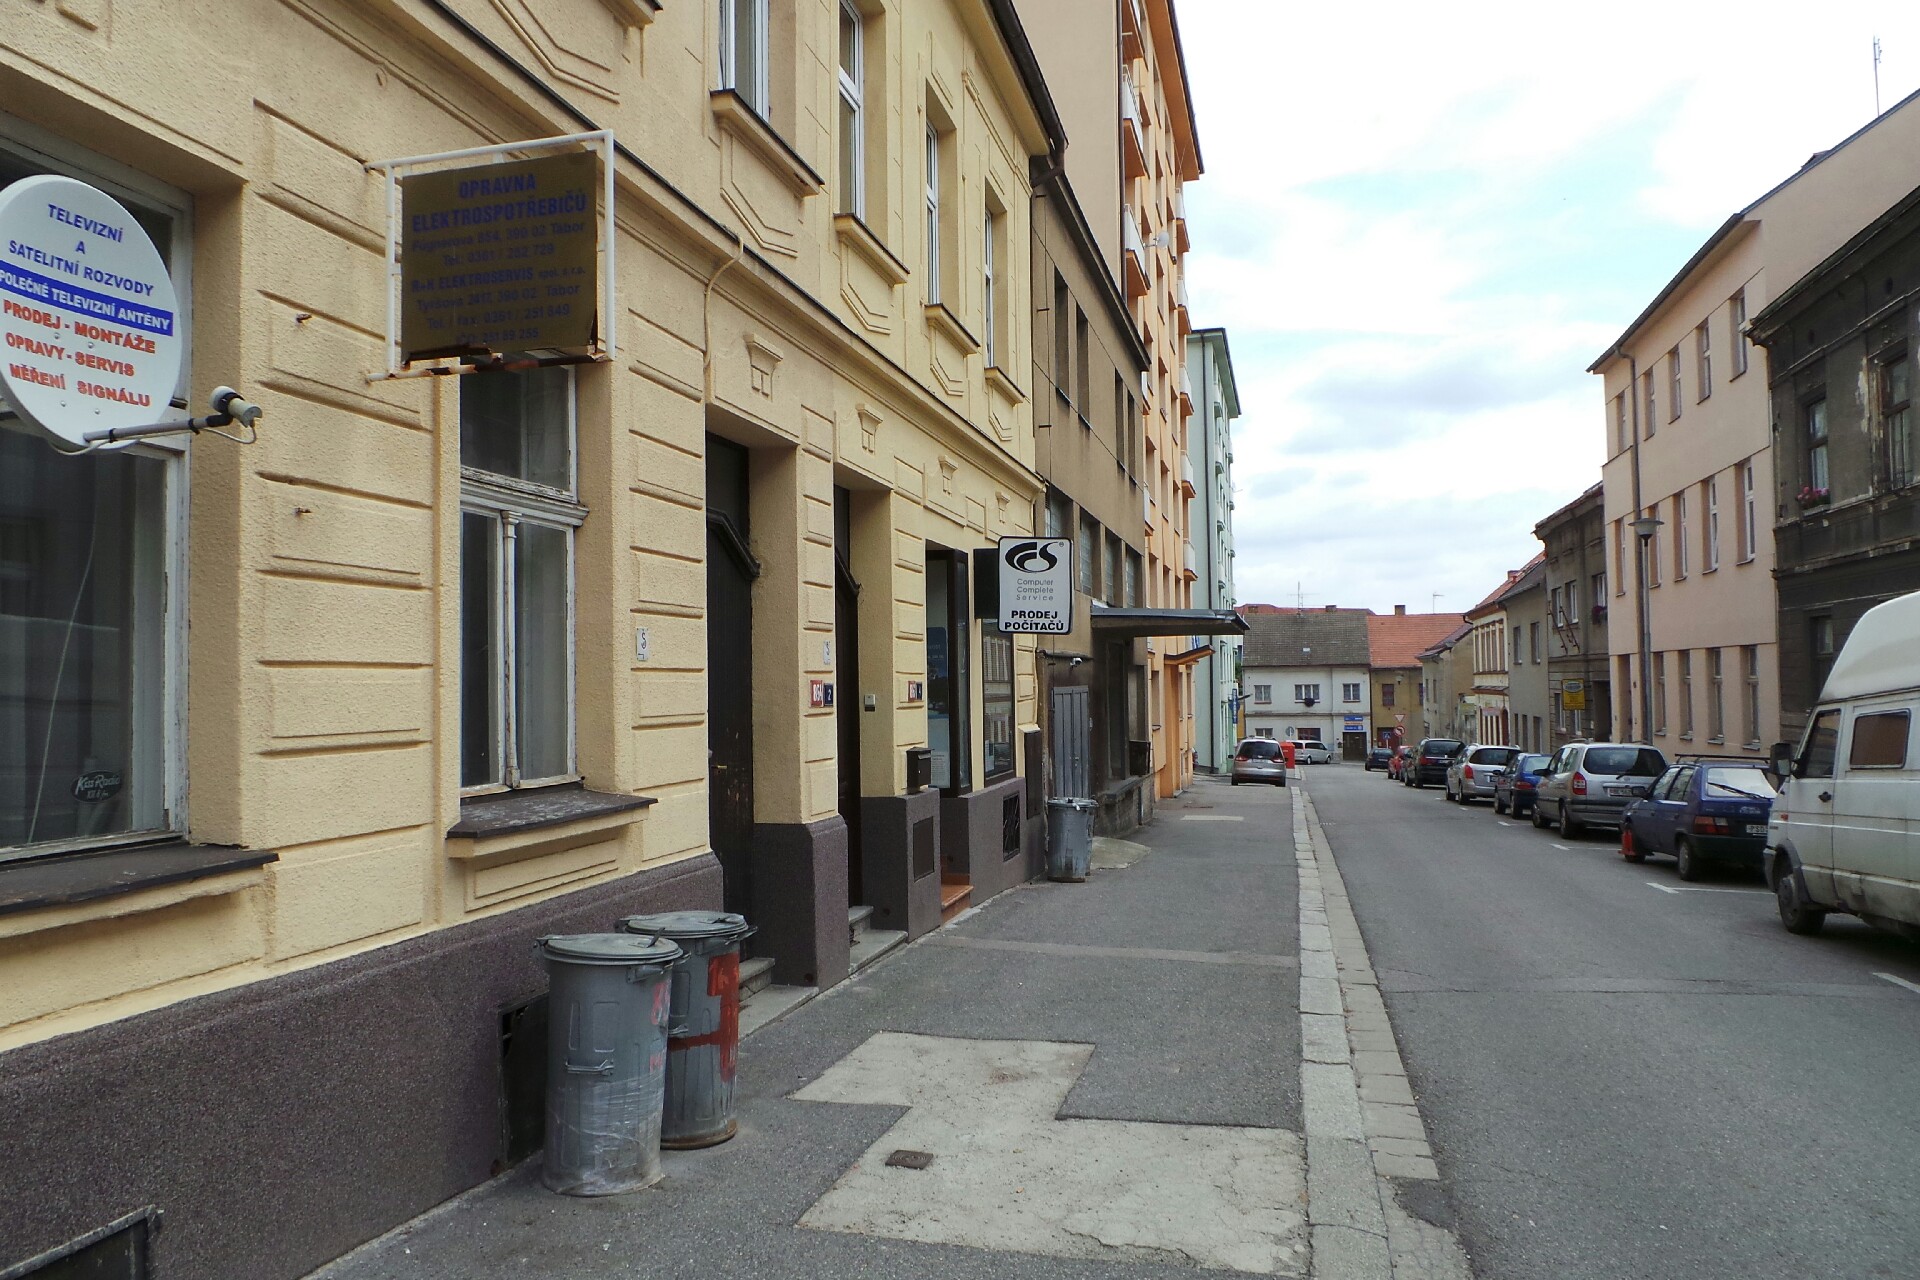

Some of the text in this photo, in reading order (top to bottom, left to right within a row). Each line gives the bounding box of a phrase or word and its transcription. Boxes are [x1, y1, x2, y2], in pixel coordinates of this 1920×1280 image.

[459, 173, 536, 198] OPRAVNA
[48, 203, 124, 243] TELEVIZNÍ
[412, 189, 587, 232] ELEKTROSPOTŘEBIČŮ
[75, 241, 86, 254] A
[9, 240, 153, 297] SATELITNÍ ROZVODY
[439, 268, 534, 289] ELEKTROSERVIS
[52, 287, 116, 318] TELEVIZNÍ
[118, 306, 170, 331] ANTÉNY
[3, 299, 61, 329] PRODEJ
[74, 321, 156, 354] MONTÁŽE
[5, 332, 65, 360] OPRAVY
[75, 351, 135, 377] SERVIS
[9, 363, 151, 407] MĚŘENÍ SIGNÁLU
[1017, 578, 1053, 586] Computer
[1017, 586, 1053, 594] Complete
[1004, 620, 1064, 631] POČÍTAČŮ
[1011, 610, 1058, 619] PRODEJ
